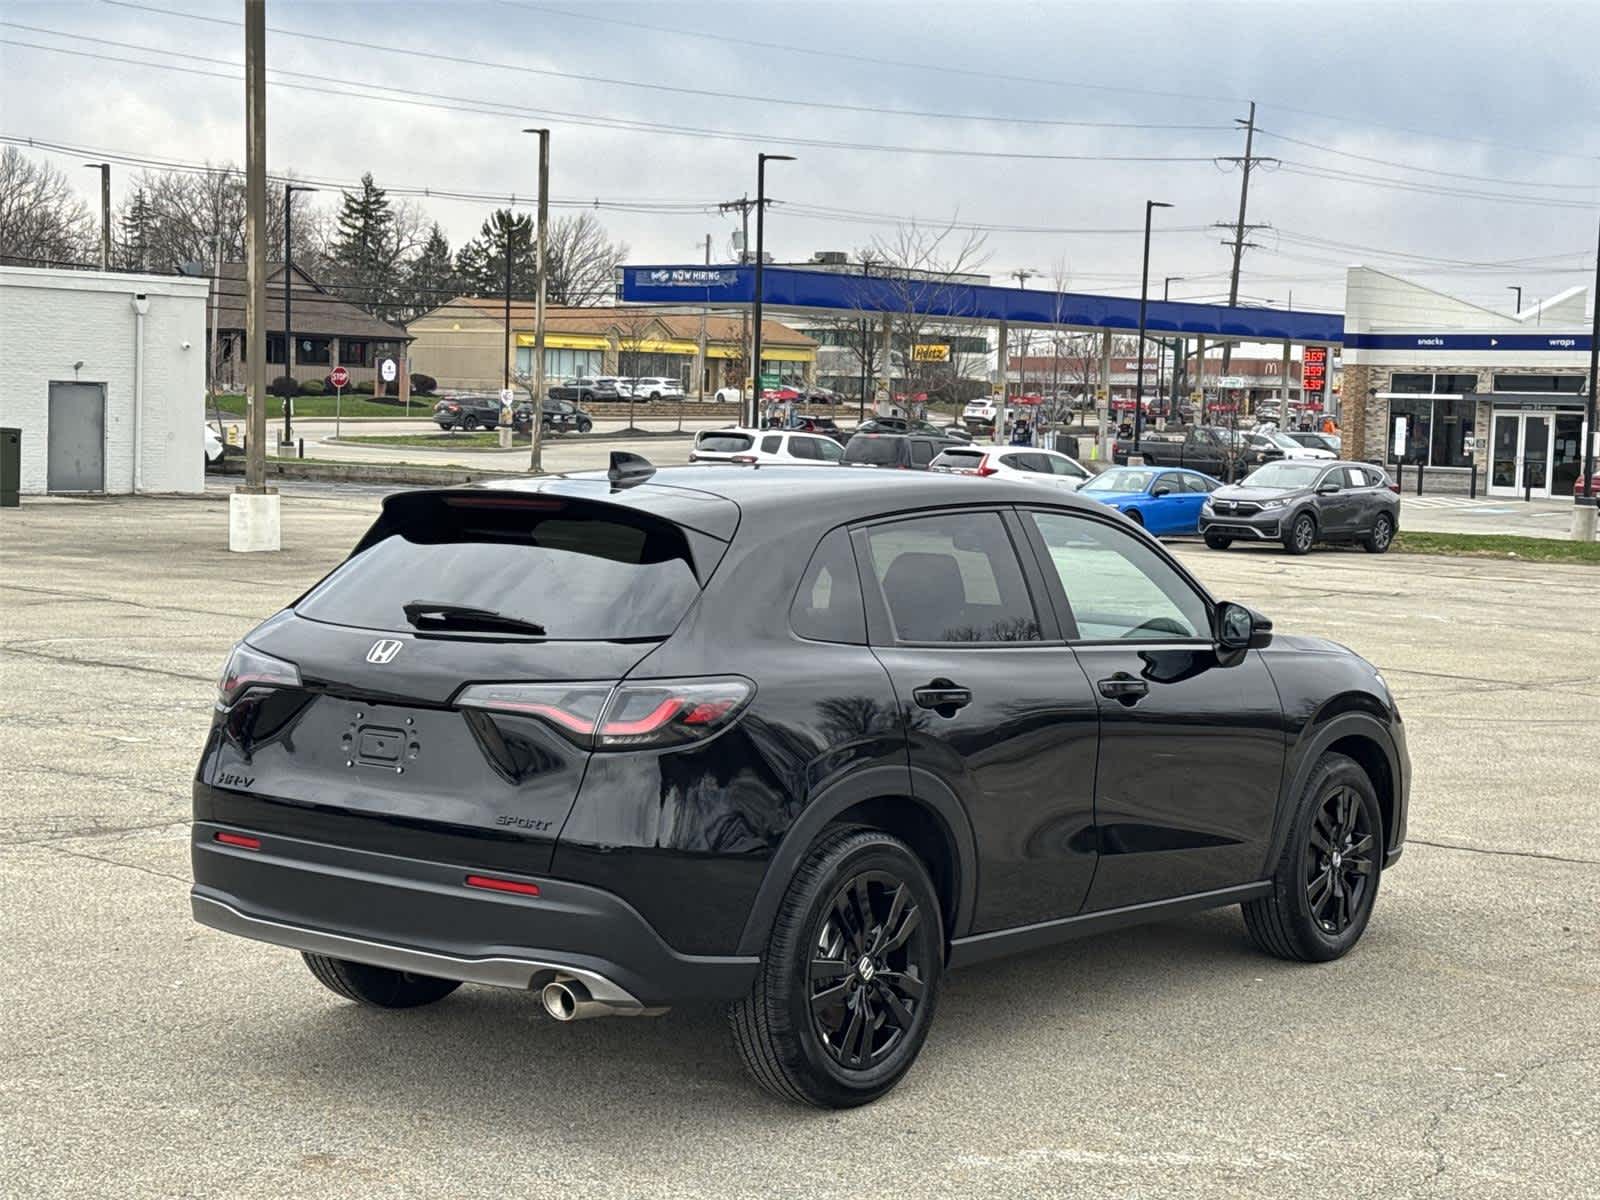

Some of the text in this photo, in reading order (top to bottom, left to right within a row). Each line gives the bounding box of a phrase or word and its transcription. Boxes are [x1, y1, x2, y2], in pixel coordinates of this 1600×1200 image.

[672, 271, 690, 281] NOW
[693, 271, 720, 281] HIRING
[1417, 338, 1575, 348] snacks wraps
[331, 372, 346, 381] STOP
[217, 772, 255, 788] HR-V
[496, 816, 553, 831] SPORT
